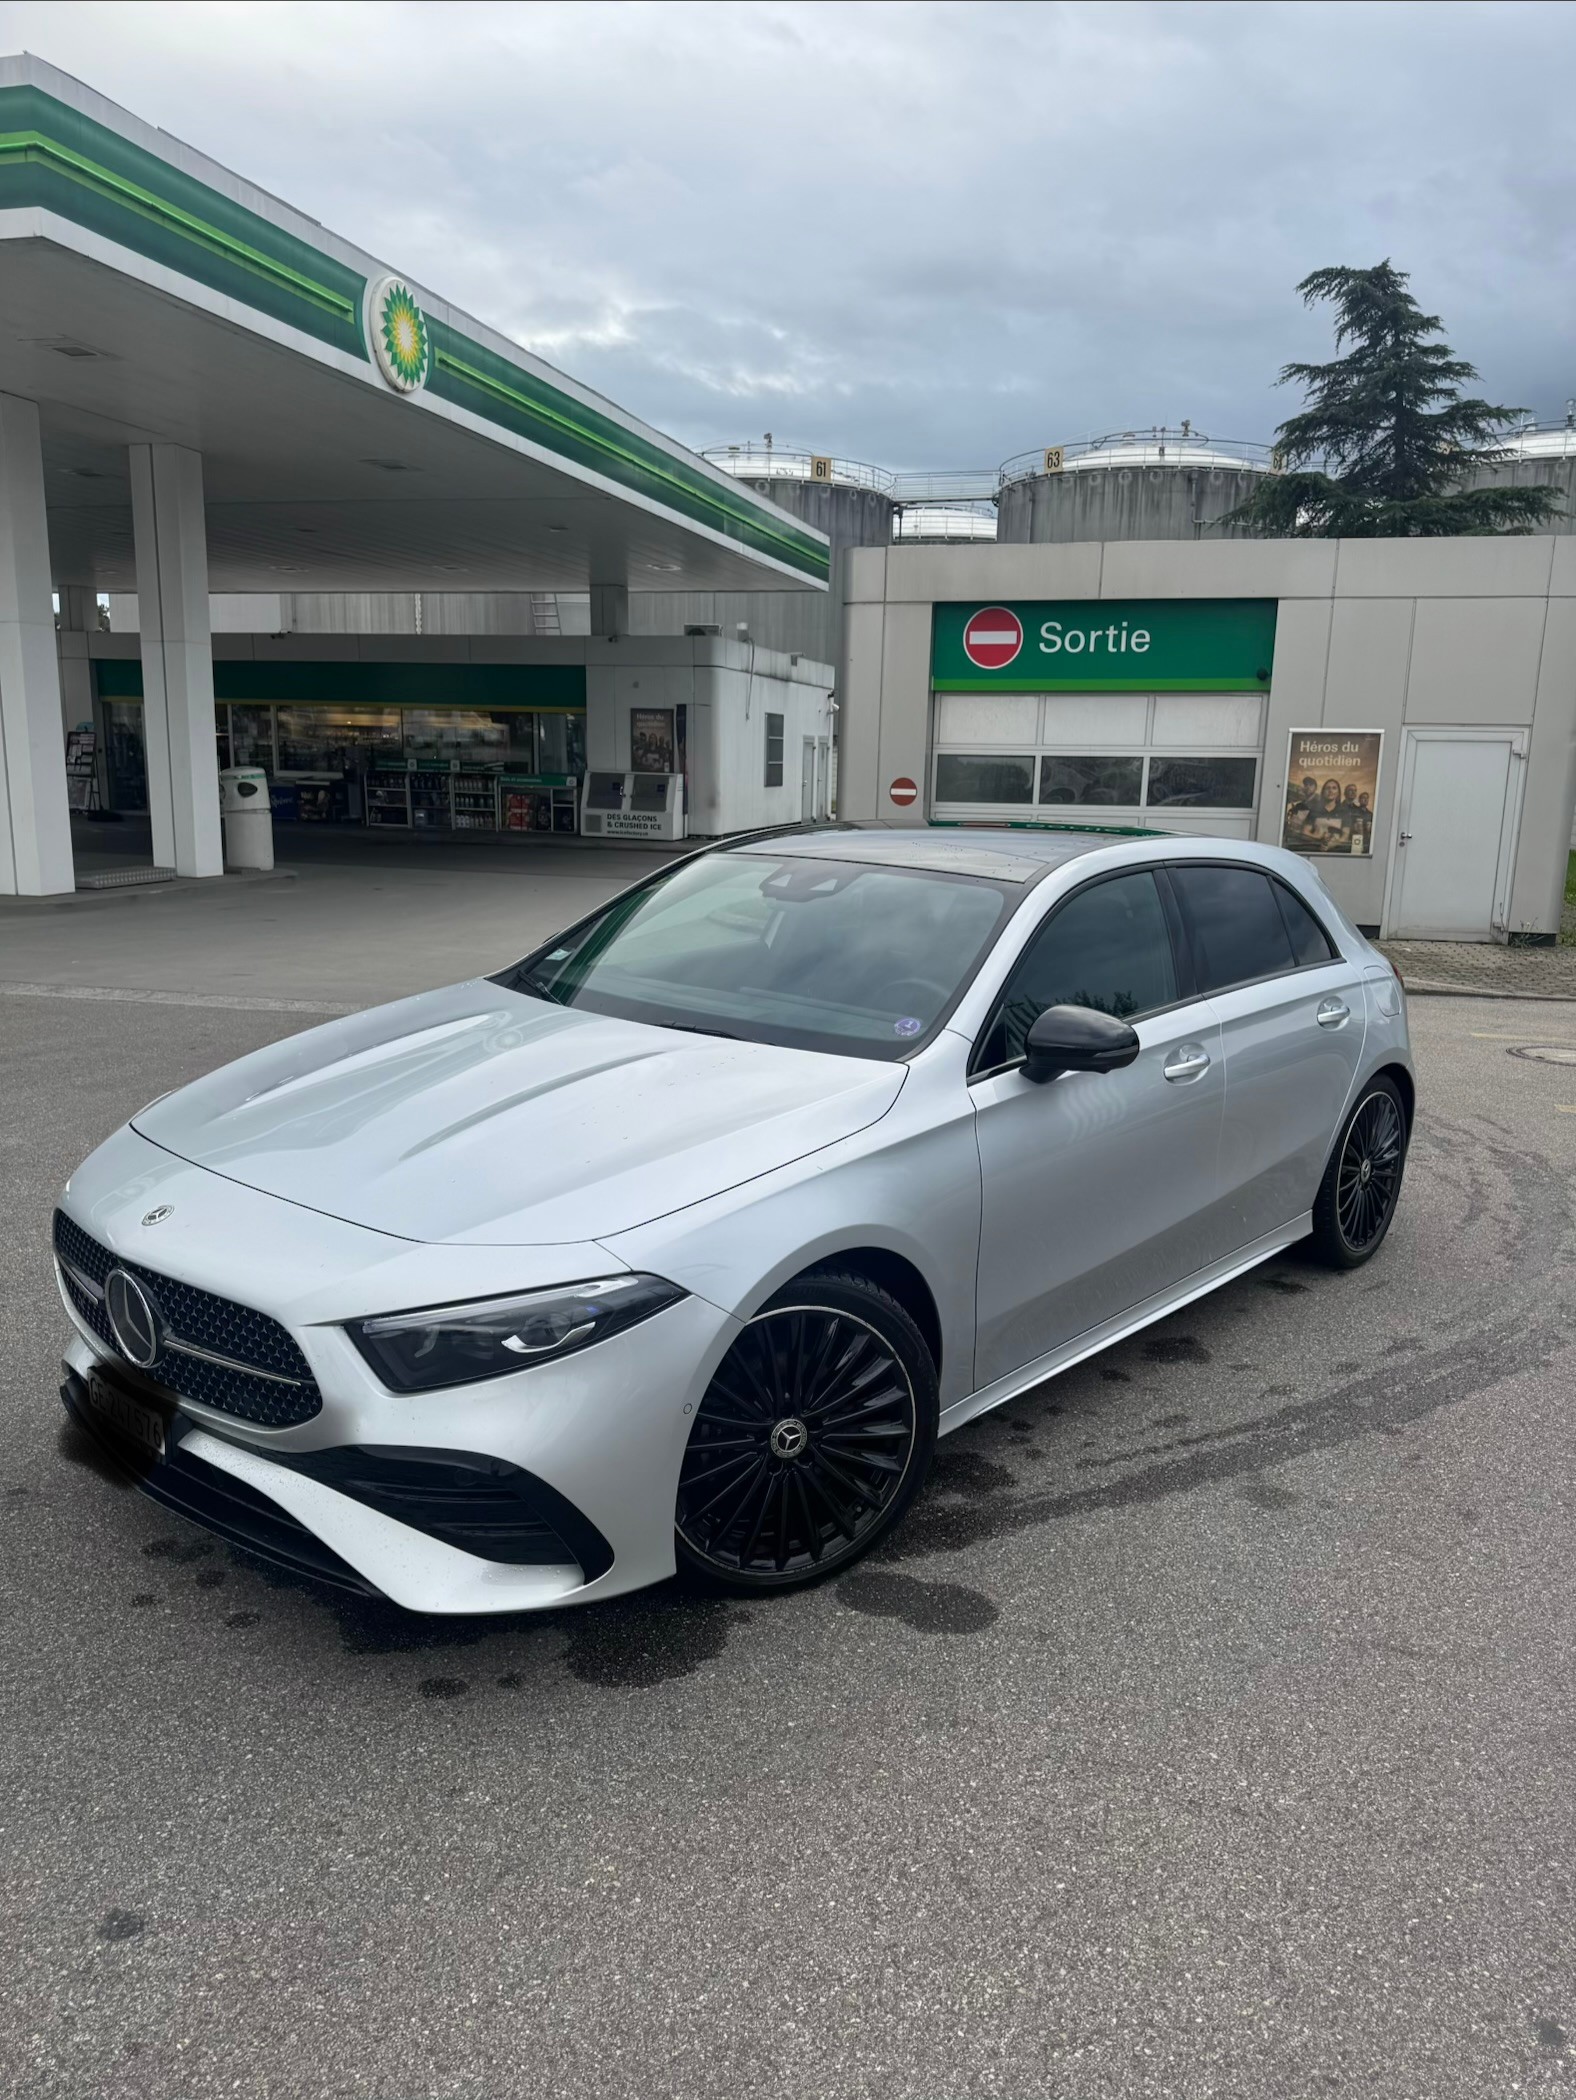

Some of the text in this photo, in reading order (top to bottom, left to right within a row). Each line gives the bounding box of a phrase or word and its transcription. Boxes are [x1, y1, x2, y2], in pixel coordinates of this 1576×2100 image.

[1047, 451, 1060, 468] 63
[816, 461, 827, 477] 61
[1039, 621, 1151, 653] Sortie
[1300, 740, 1359, 753] Héros du
[1299, 755, 1361, 768] quotidien
[622, 814, 657, 822] GLAÇONS
[614, 821, 649, 830] CRUSHED
